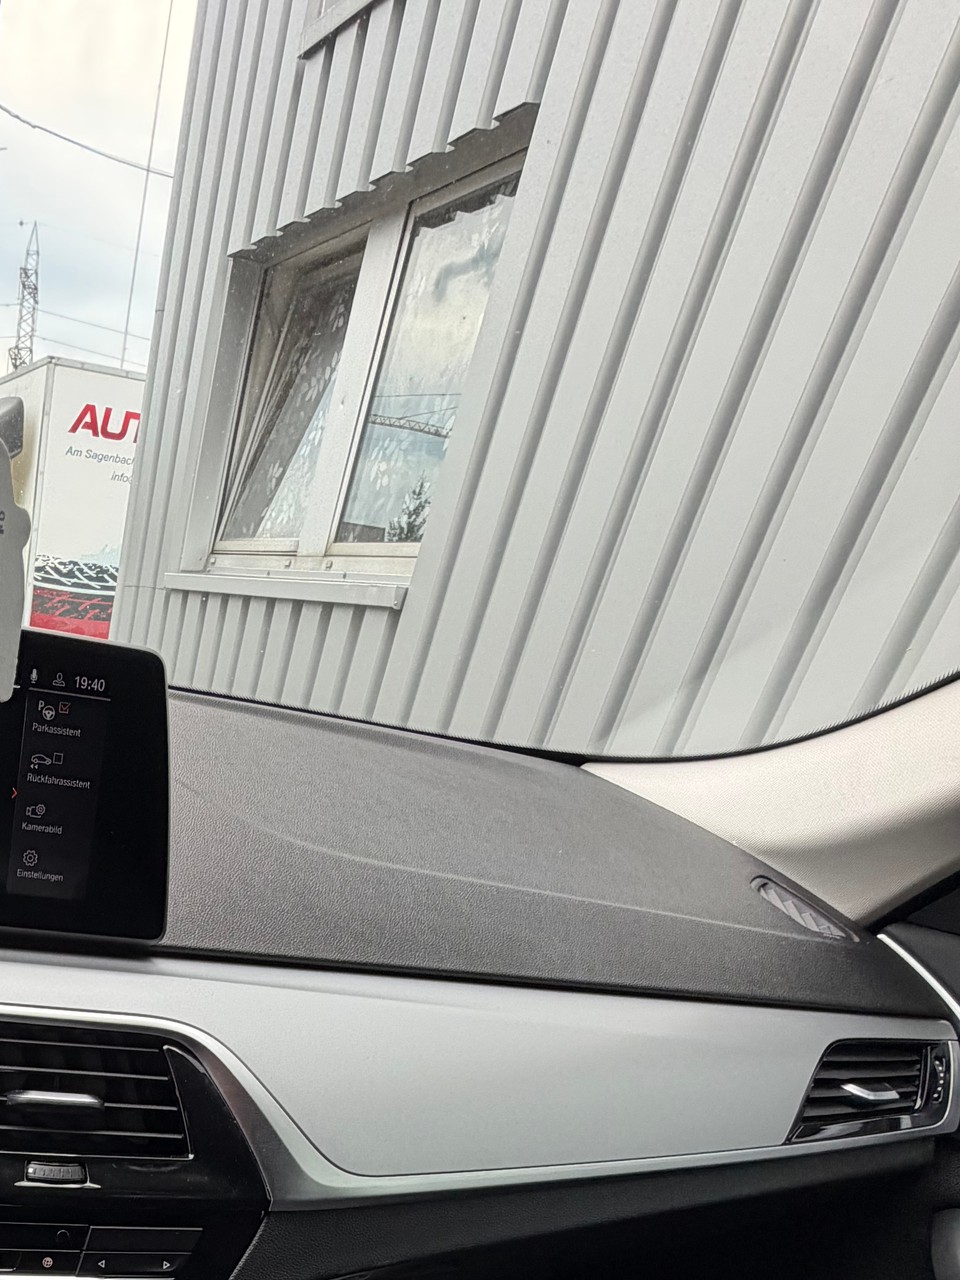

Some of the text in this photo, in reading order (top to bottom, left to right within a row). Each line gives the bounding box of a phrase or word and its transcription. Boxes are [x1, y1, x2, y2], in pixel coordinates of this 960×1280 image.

[65, 446, 83, 457] Am
[74, 676, 106, 692] 19:40
[32, 722, 81, 737] Parkassistent
[26, 772, 91, 789] Rückfahrassistent
[21, 821, 63, 835] Kamerabild
[16, 868, 64, 882] Einstellungen
